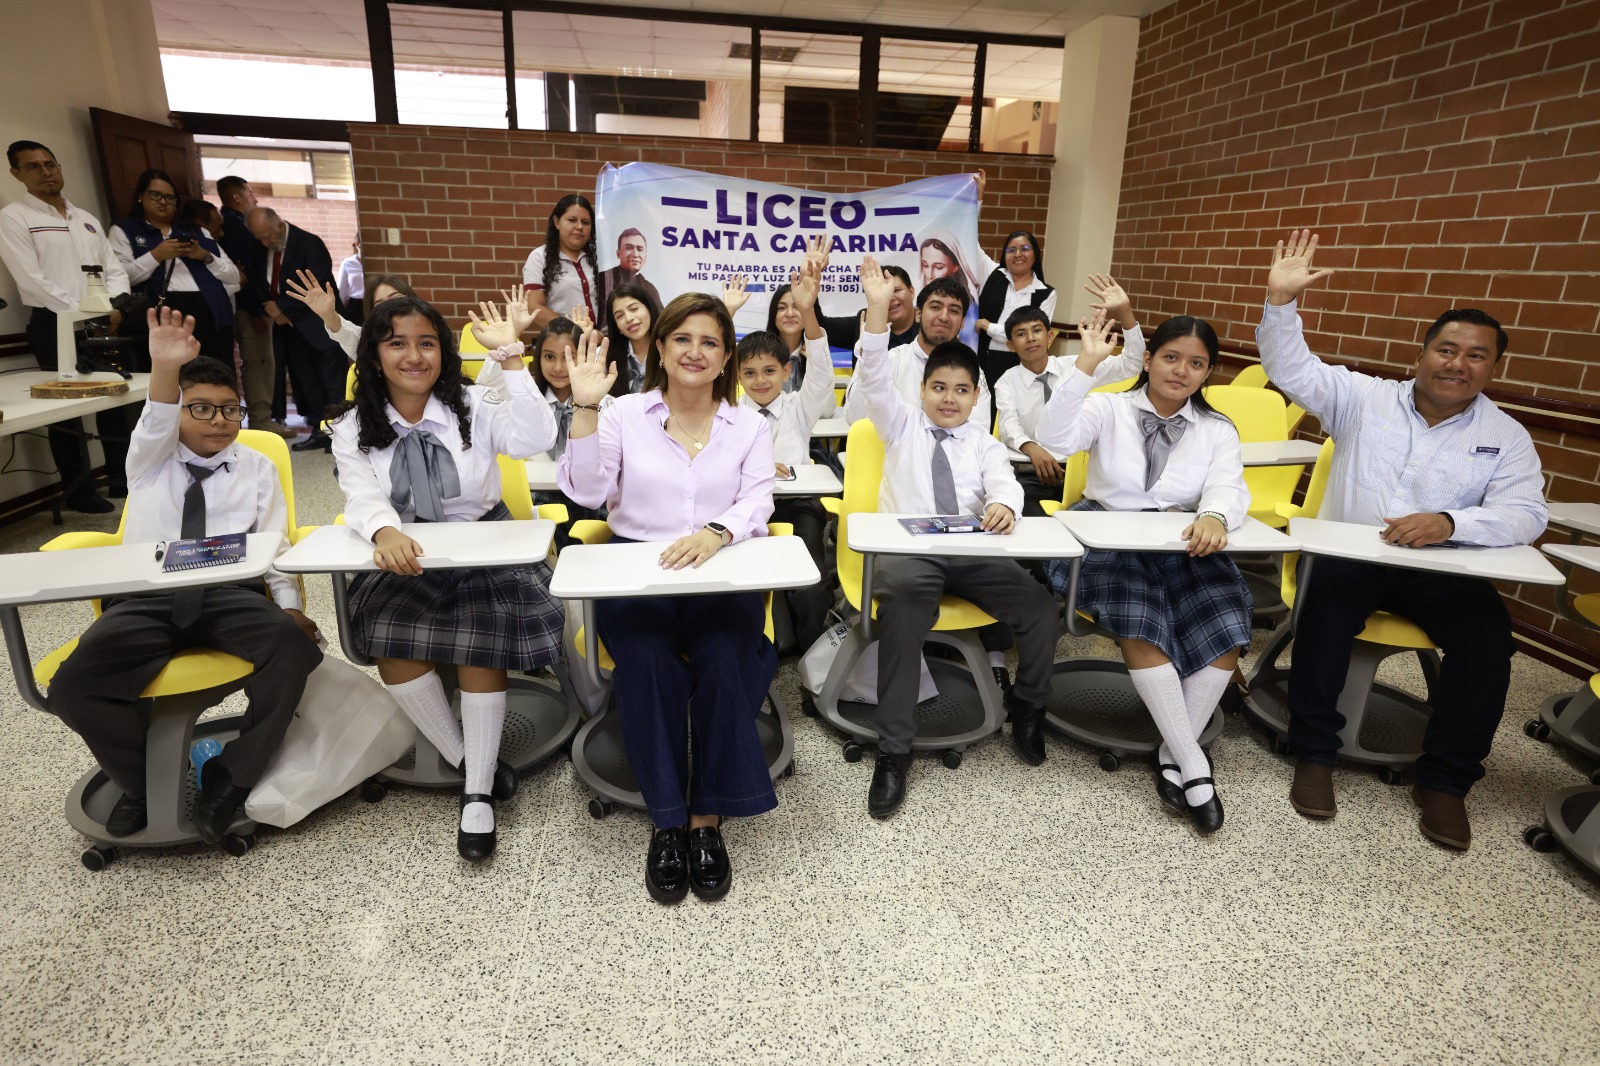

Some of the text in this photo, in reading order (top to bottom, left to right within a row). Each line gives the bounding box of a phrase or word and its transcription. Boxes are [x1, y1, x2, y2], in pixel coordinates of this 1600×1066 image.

[716, 189, 866, 229] LICEO
[661, 226, 760, 252] SANTA
[697, 263, 711, 271] TU
[715, 263, 768, 273] PALABRA
[772, 265, 785, 273] ES
[789, 265, 852, 273] ARCHA
[688, 272, 708, 281] MIS
[753, 274, 760, 282] Y
[763, 274, 785, 282] LUZ
[839, 284, 859, 293] 105)
